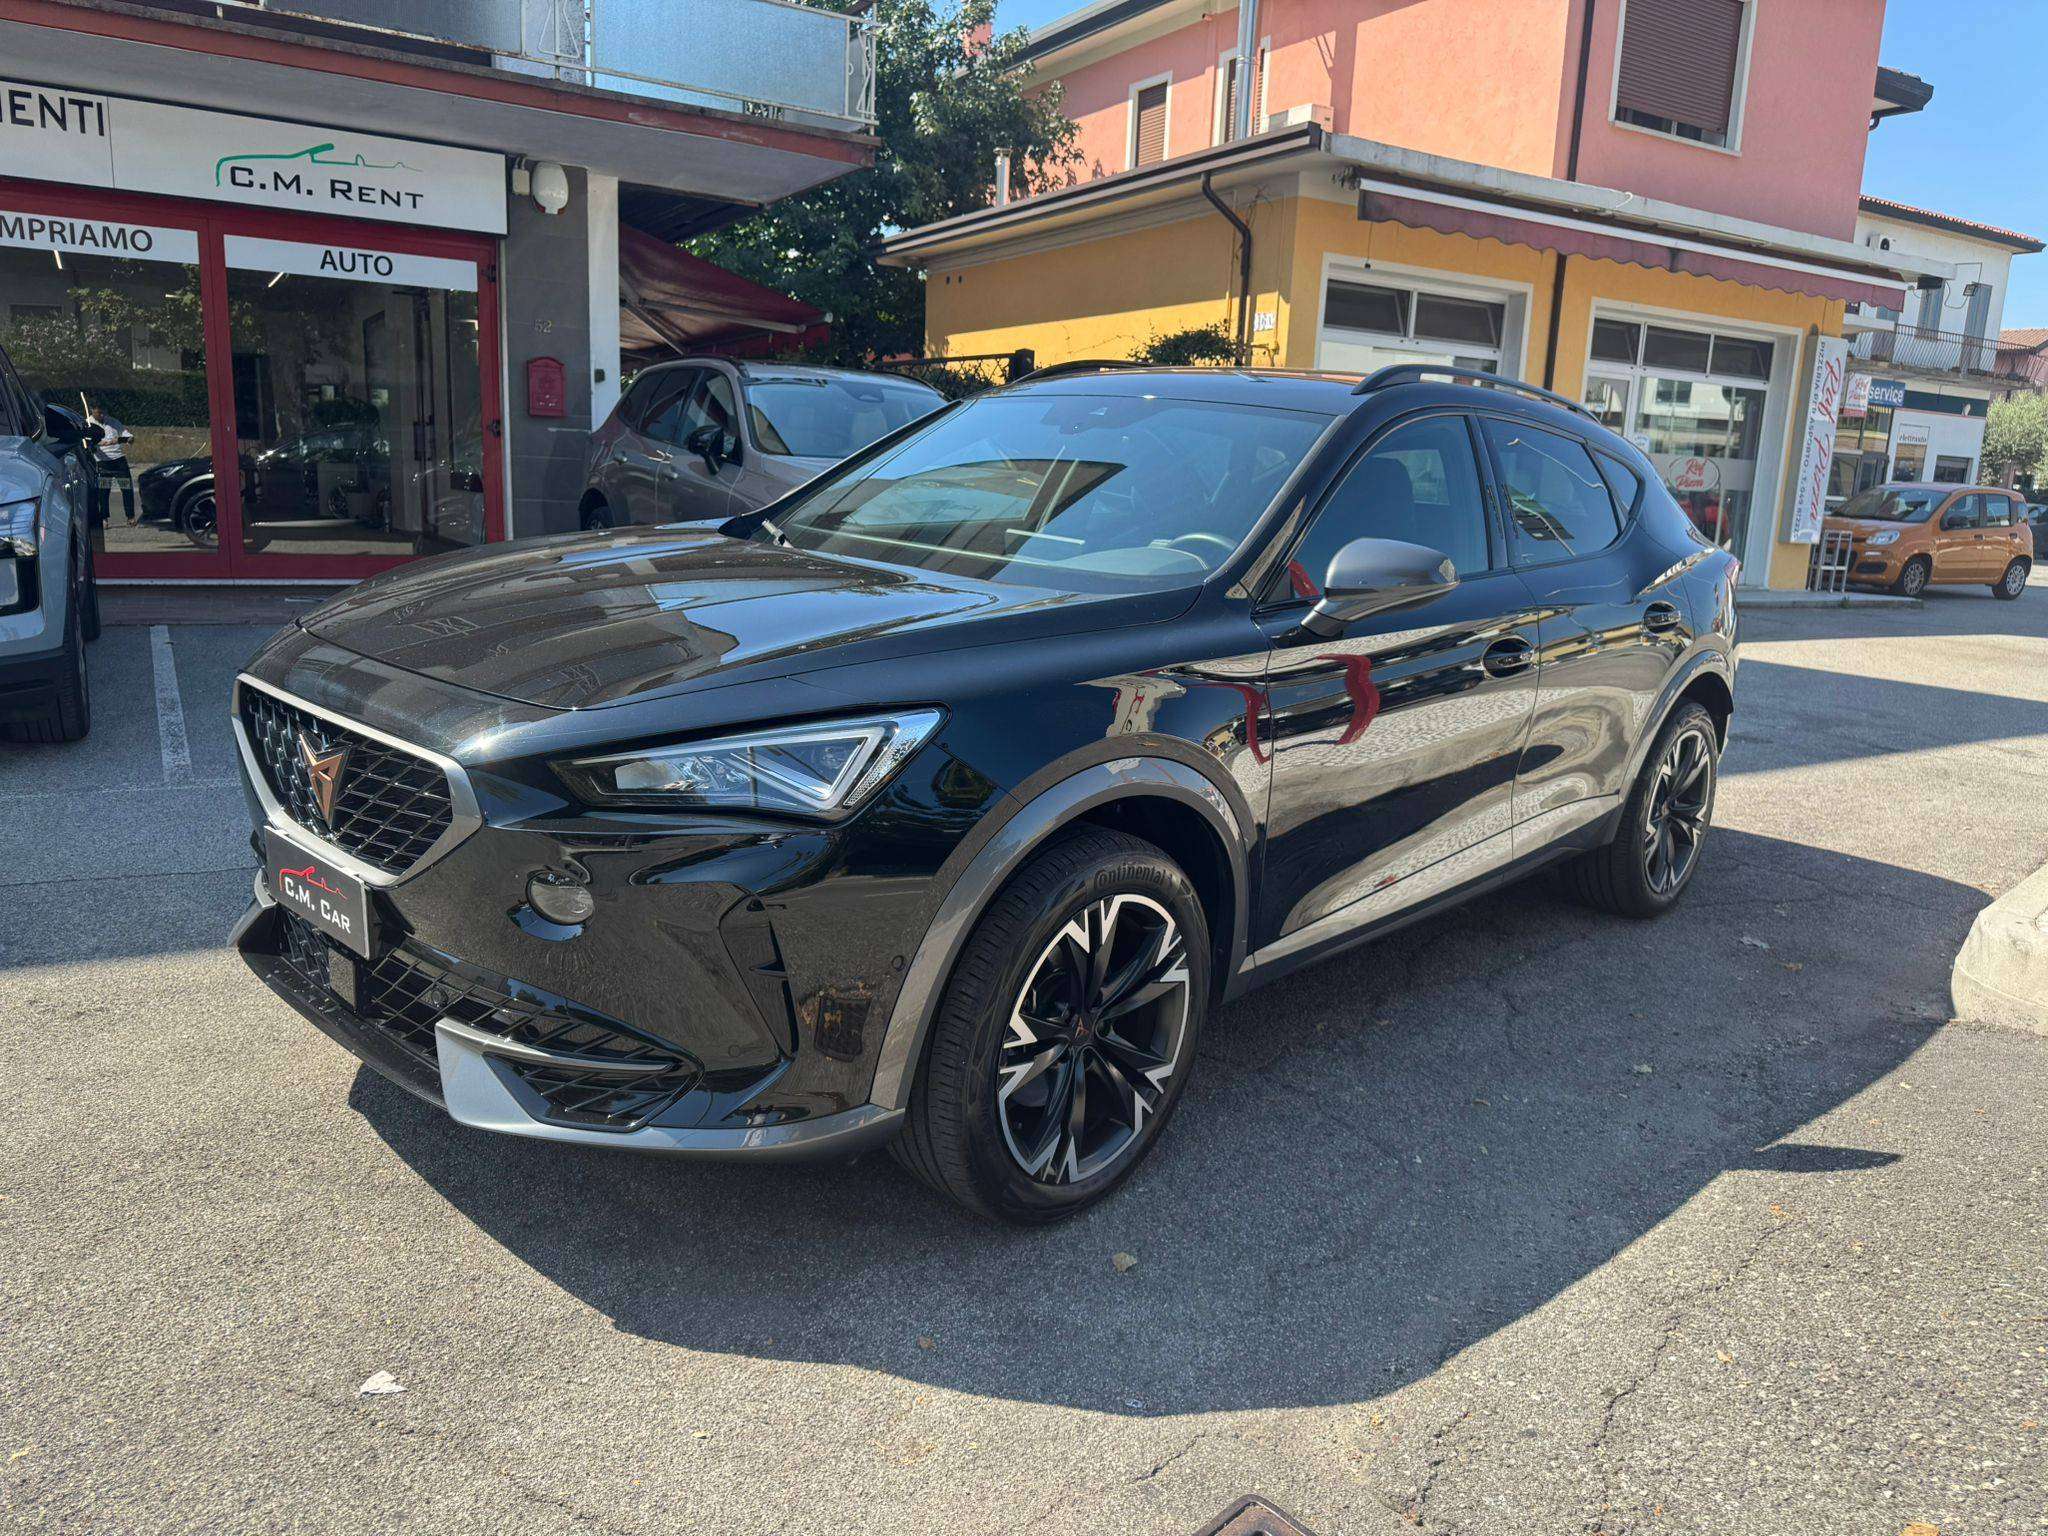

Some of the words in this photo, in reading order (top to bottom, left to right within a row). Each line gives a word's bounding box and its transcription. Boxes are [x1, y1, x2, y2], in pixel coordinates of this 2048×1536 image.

[0, 89, 104, 137] ENTI
[230, 165, 314, 196] C.M.
[329, 178, 424, 210] RENT
[0, 214, 153, 252] MPRIAMO
[320, 249, 393, 277] AUTO
[1868, 385, 1904, 404] service
[1810, 432, 1830, 521] Pizza
[1094, 862, 1166, 890] Continental
[284, 876, 315, 911] C.M.
[320, 899, 351, 933] CAR
